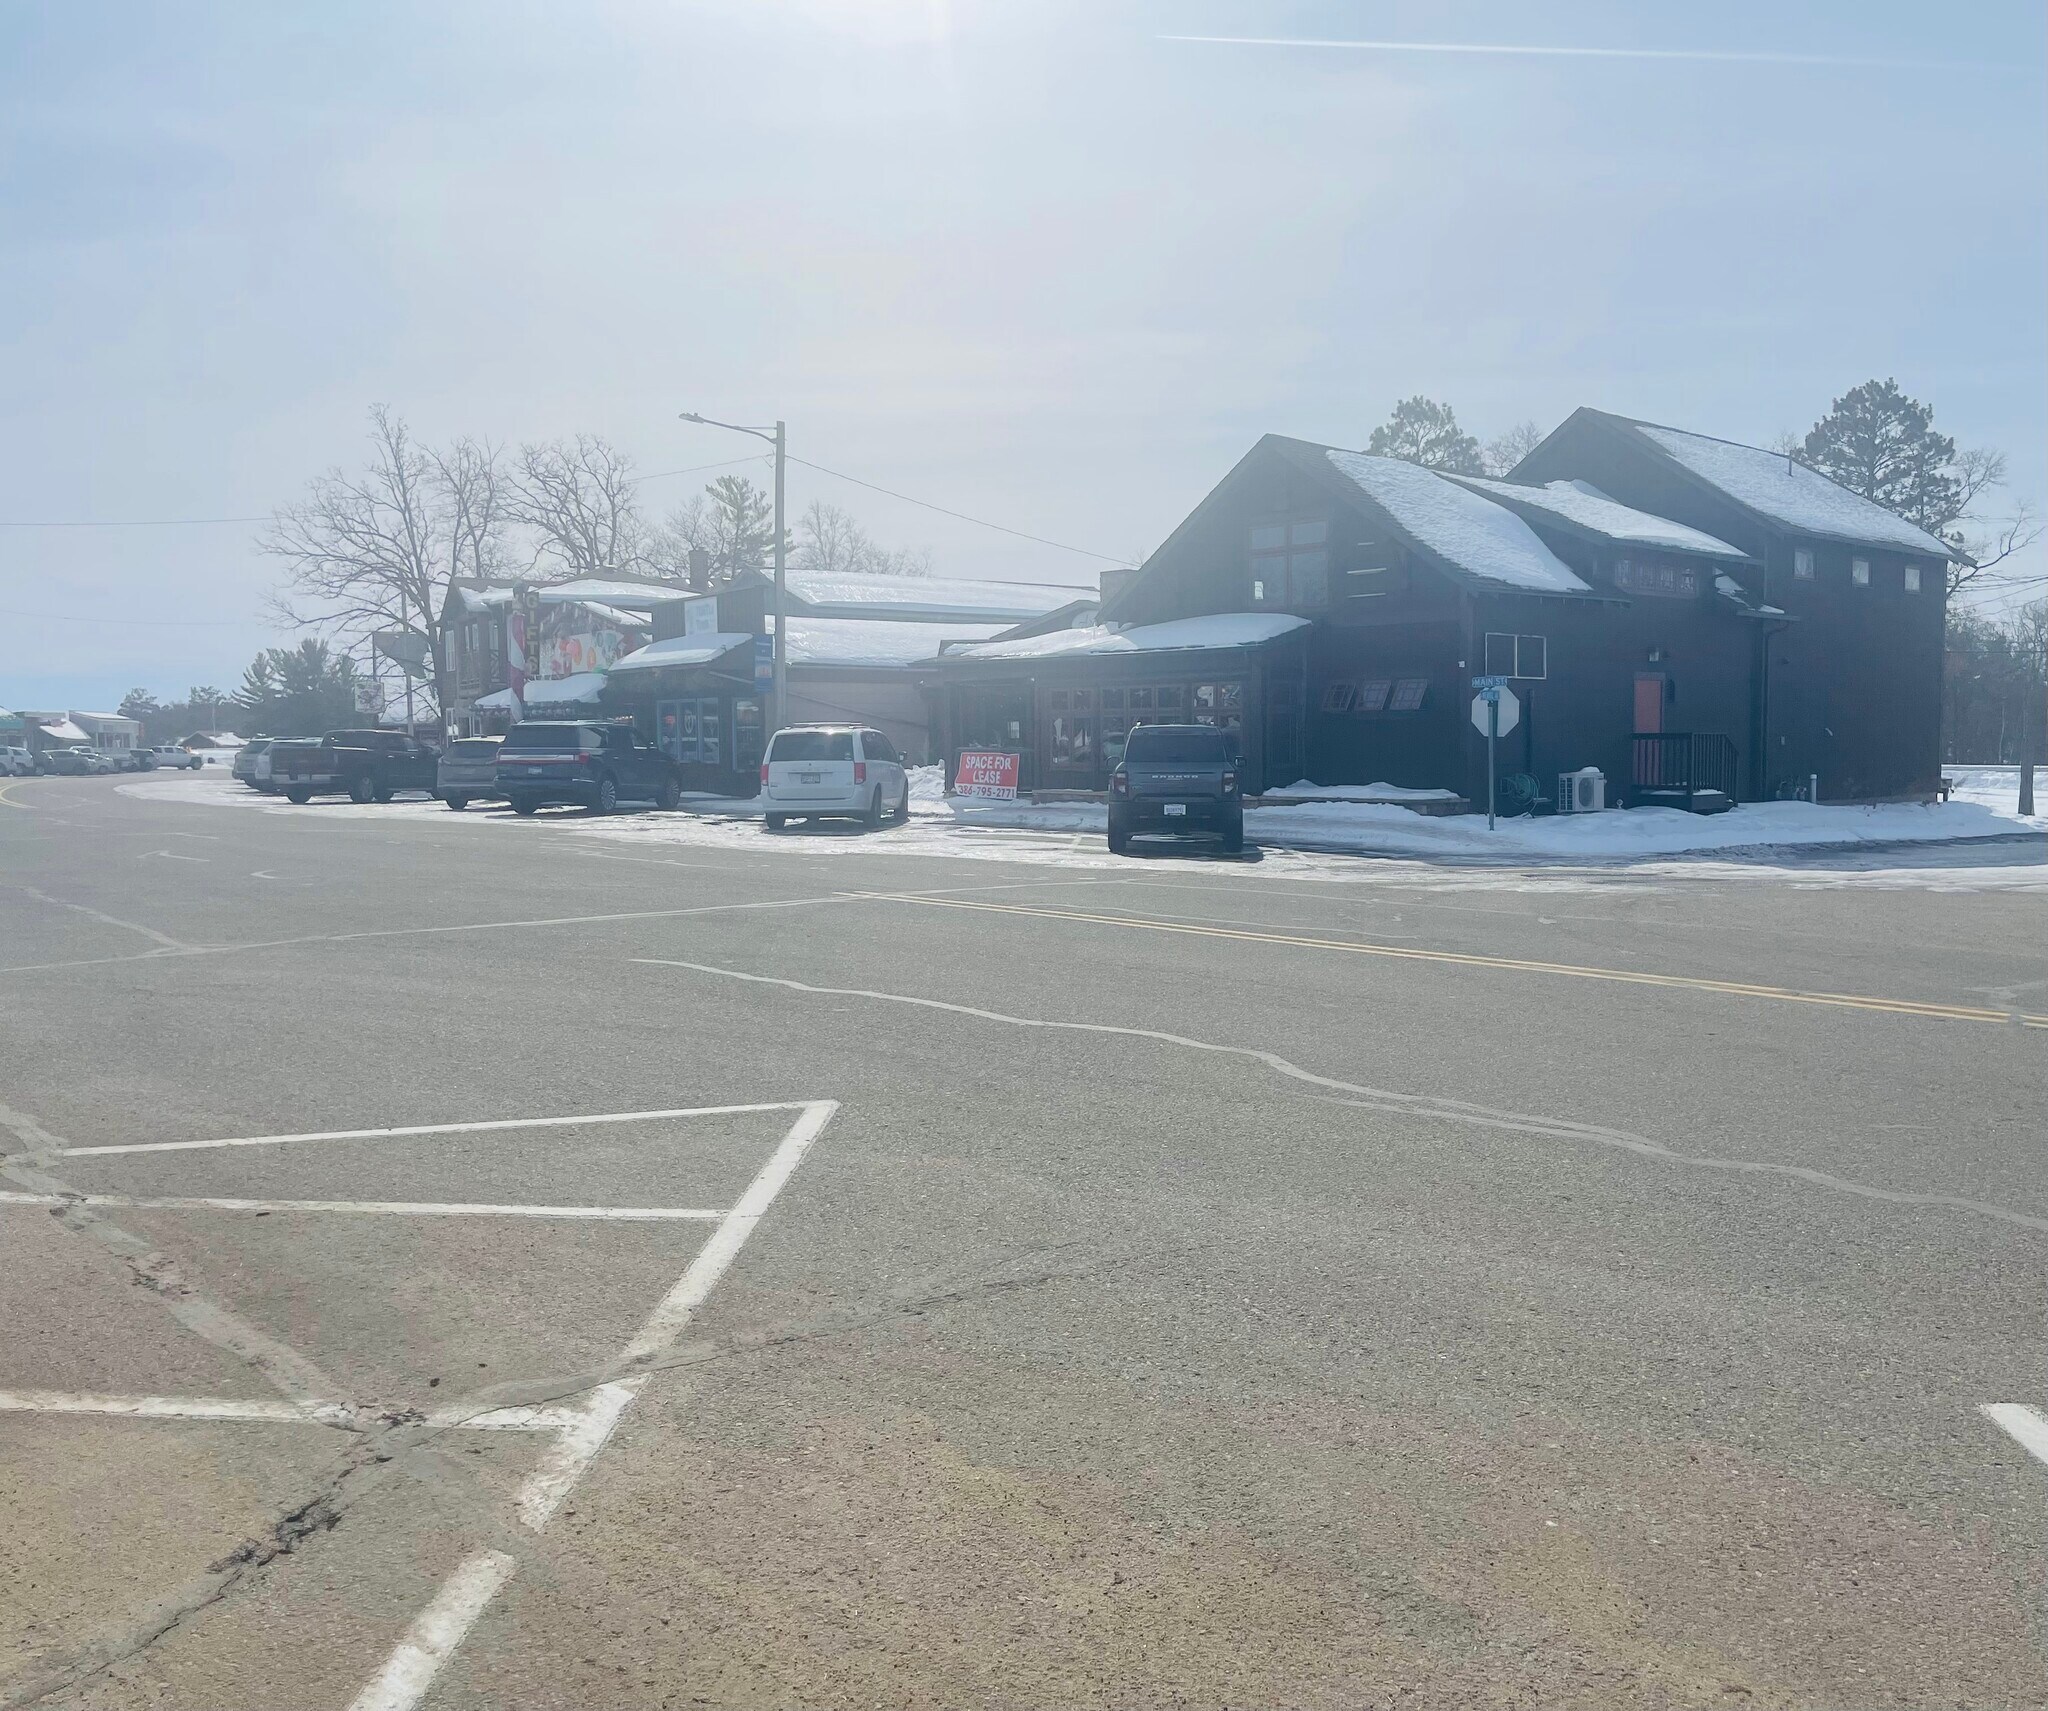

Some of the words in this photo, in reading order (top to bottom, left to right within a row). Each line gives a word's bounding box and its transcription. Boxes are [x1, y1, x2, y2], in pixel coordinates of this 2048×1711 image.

[526, 595, 539, 673] GIFTS
[1474, 677, 1493, 687] MAIN
[966, 755, 993, 769] SPACE
[995, 756, 1012, 770] FOR
[972, 770, 1000, 784] LEASE
